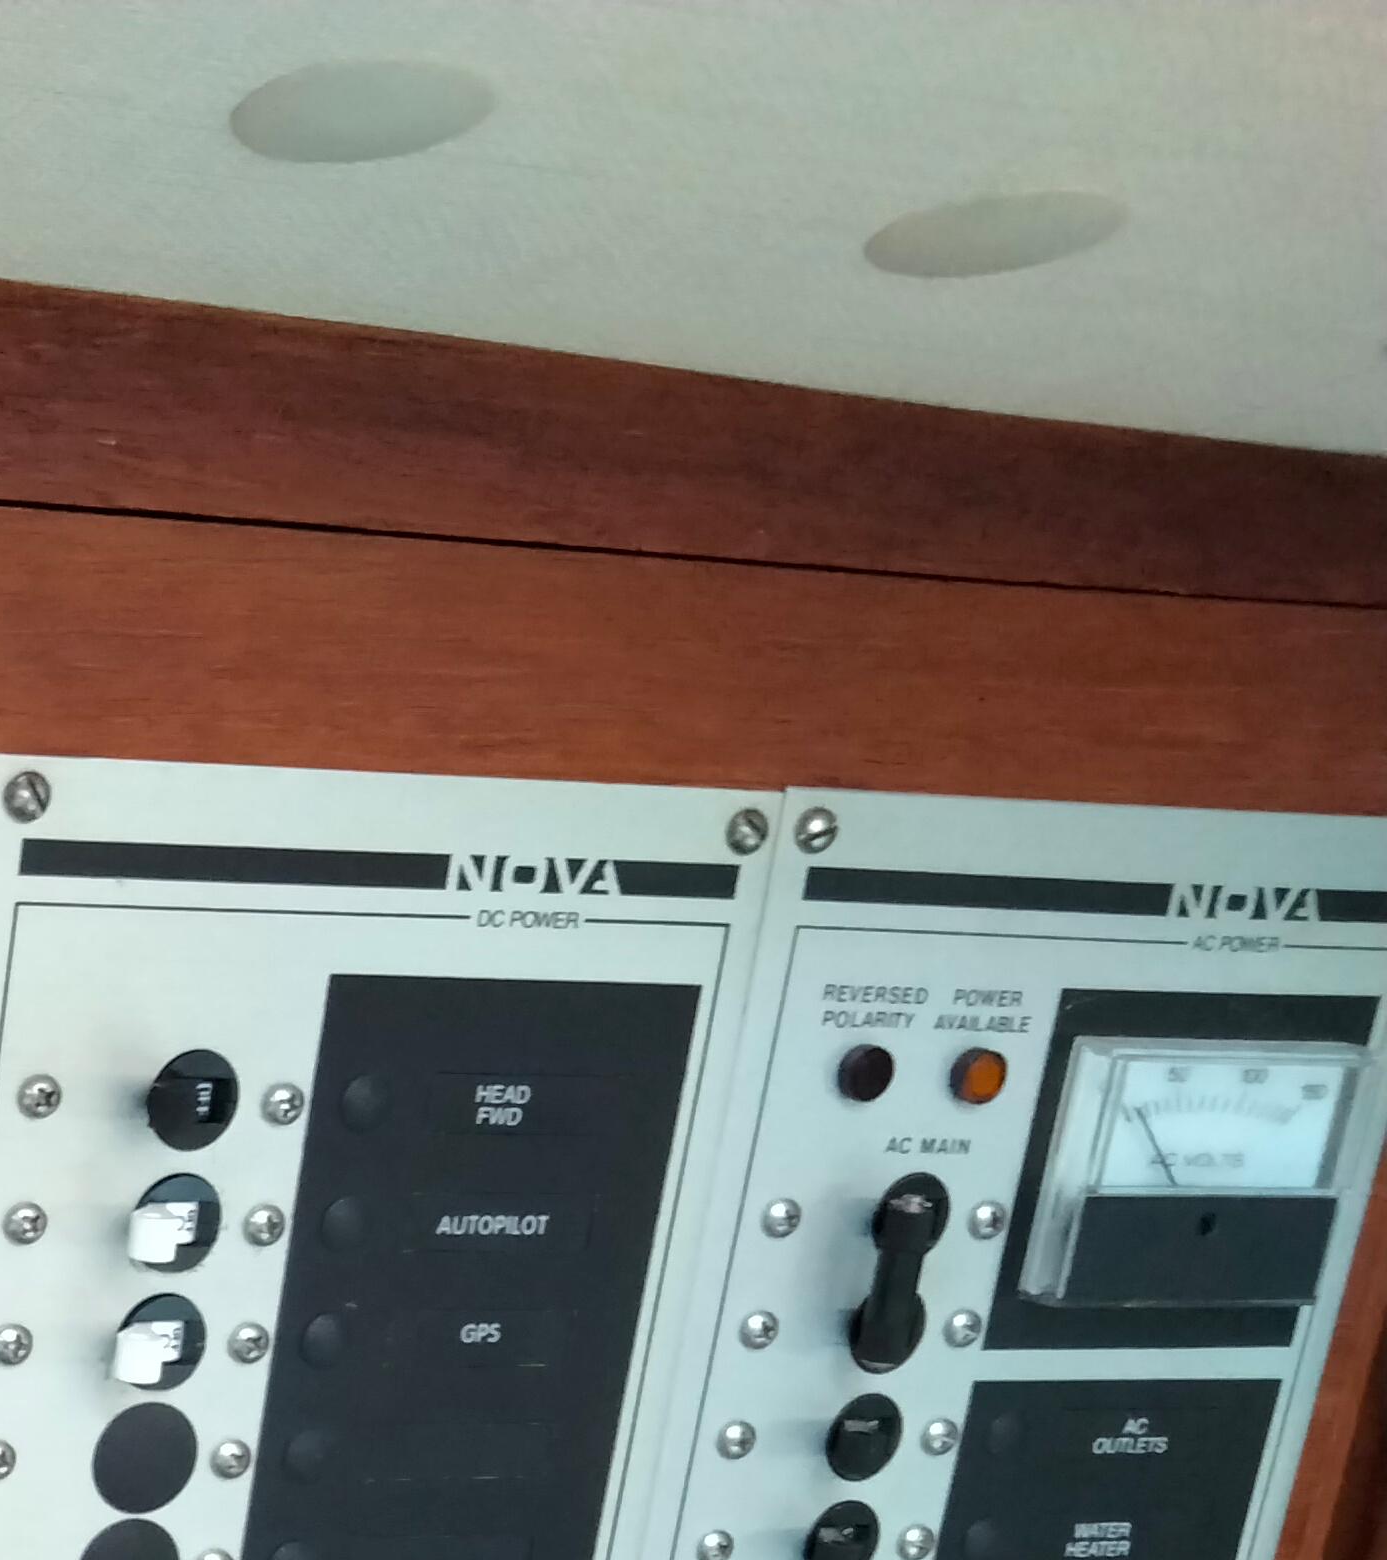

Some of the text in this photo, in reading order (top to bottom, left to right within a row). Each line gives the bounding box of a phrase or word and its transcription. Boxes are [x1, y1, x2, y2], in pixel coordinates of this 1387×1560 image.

[446, 853, 622, 897] NOVA
[1166, 882, 1321, 922] NOVA
[476, 909, 580, 930] DC POWER
[1192, 934, 1280, 953] AC POWER
[822, 983, 930, 1005] REVERSED
[953, 988, 1024, 1008] POWER
[821, 1010, 916, 1029] POLARITY
[933, 1013, 1033, 1033] AVAILABLE
[475, 1084, 531, 1105] HEAD
[476, 1106, 524, 1127] FWD
[884, 1136, 972, 1156] AC MAIN
[435, 1214, 550, 1237] AUTOPILOT
[459, 1323, 502, 1344] GPS
[1122, 1416, 1150, 1435] AC
[1091, 1436, 1169, 1455] OUTLETS
[1073, 1521, 1133, 1538] WATER
[1063, 1540, 1132, 1558] HEATER
